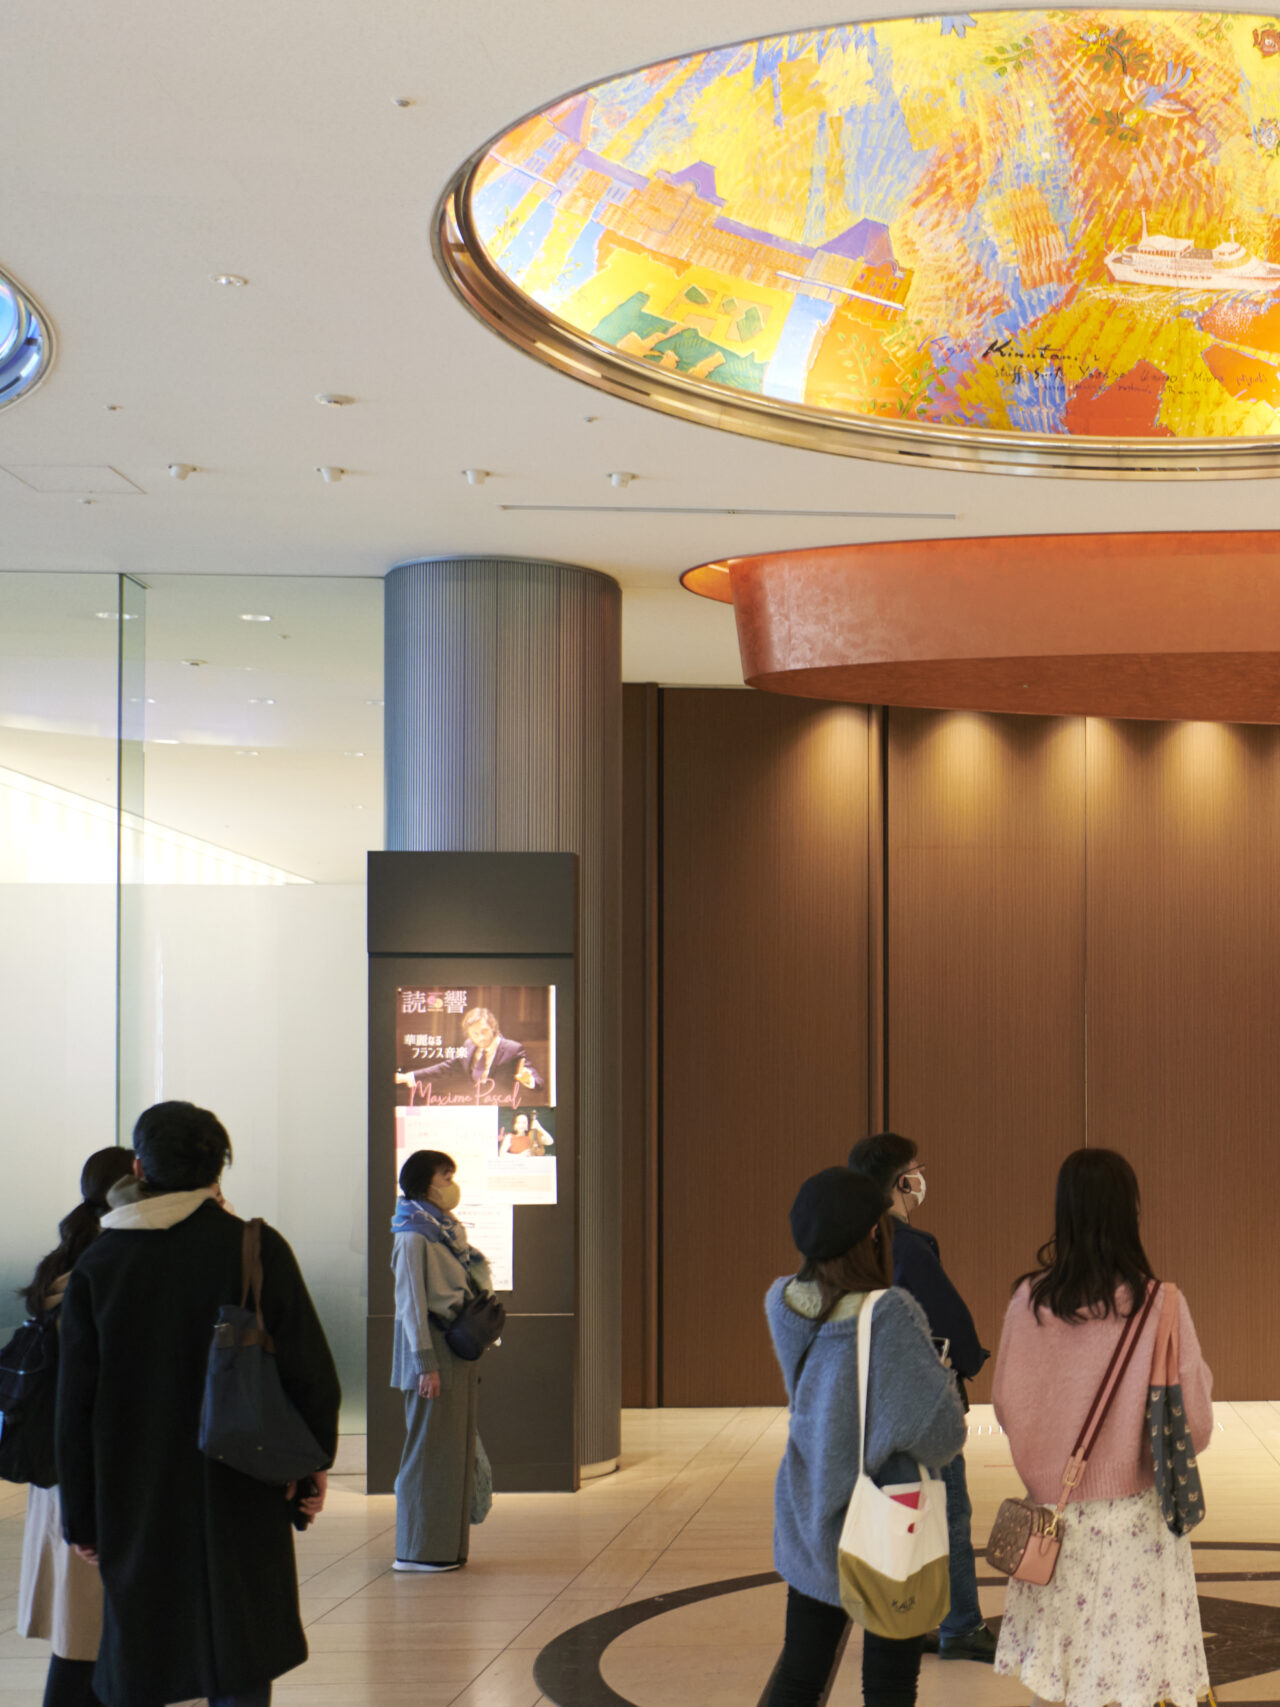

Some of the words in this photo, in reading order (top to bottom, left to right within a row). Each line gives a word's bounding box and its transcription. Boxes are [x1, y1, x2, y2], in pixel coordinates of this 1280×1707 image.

[412, 1047, 468, 1059] フランス音楽
[409, 1080, 473, 1107] Maxime
[474, 1078, 522, 1109] Pascal
